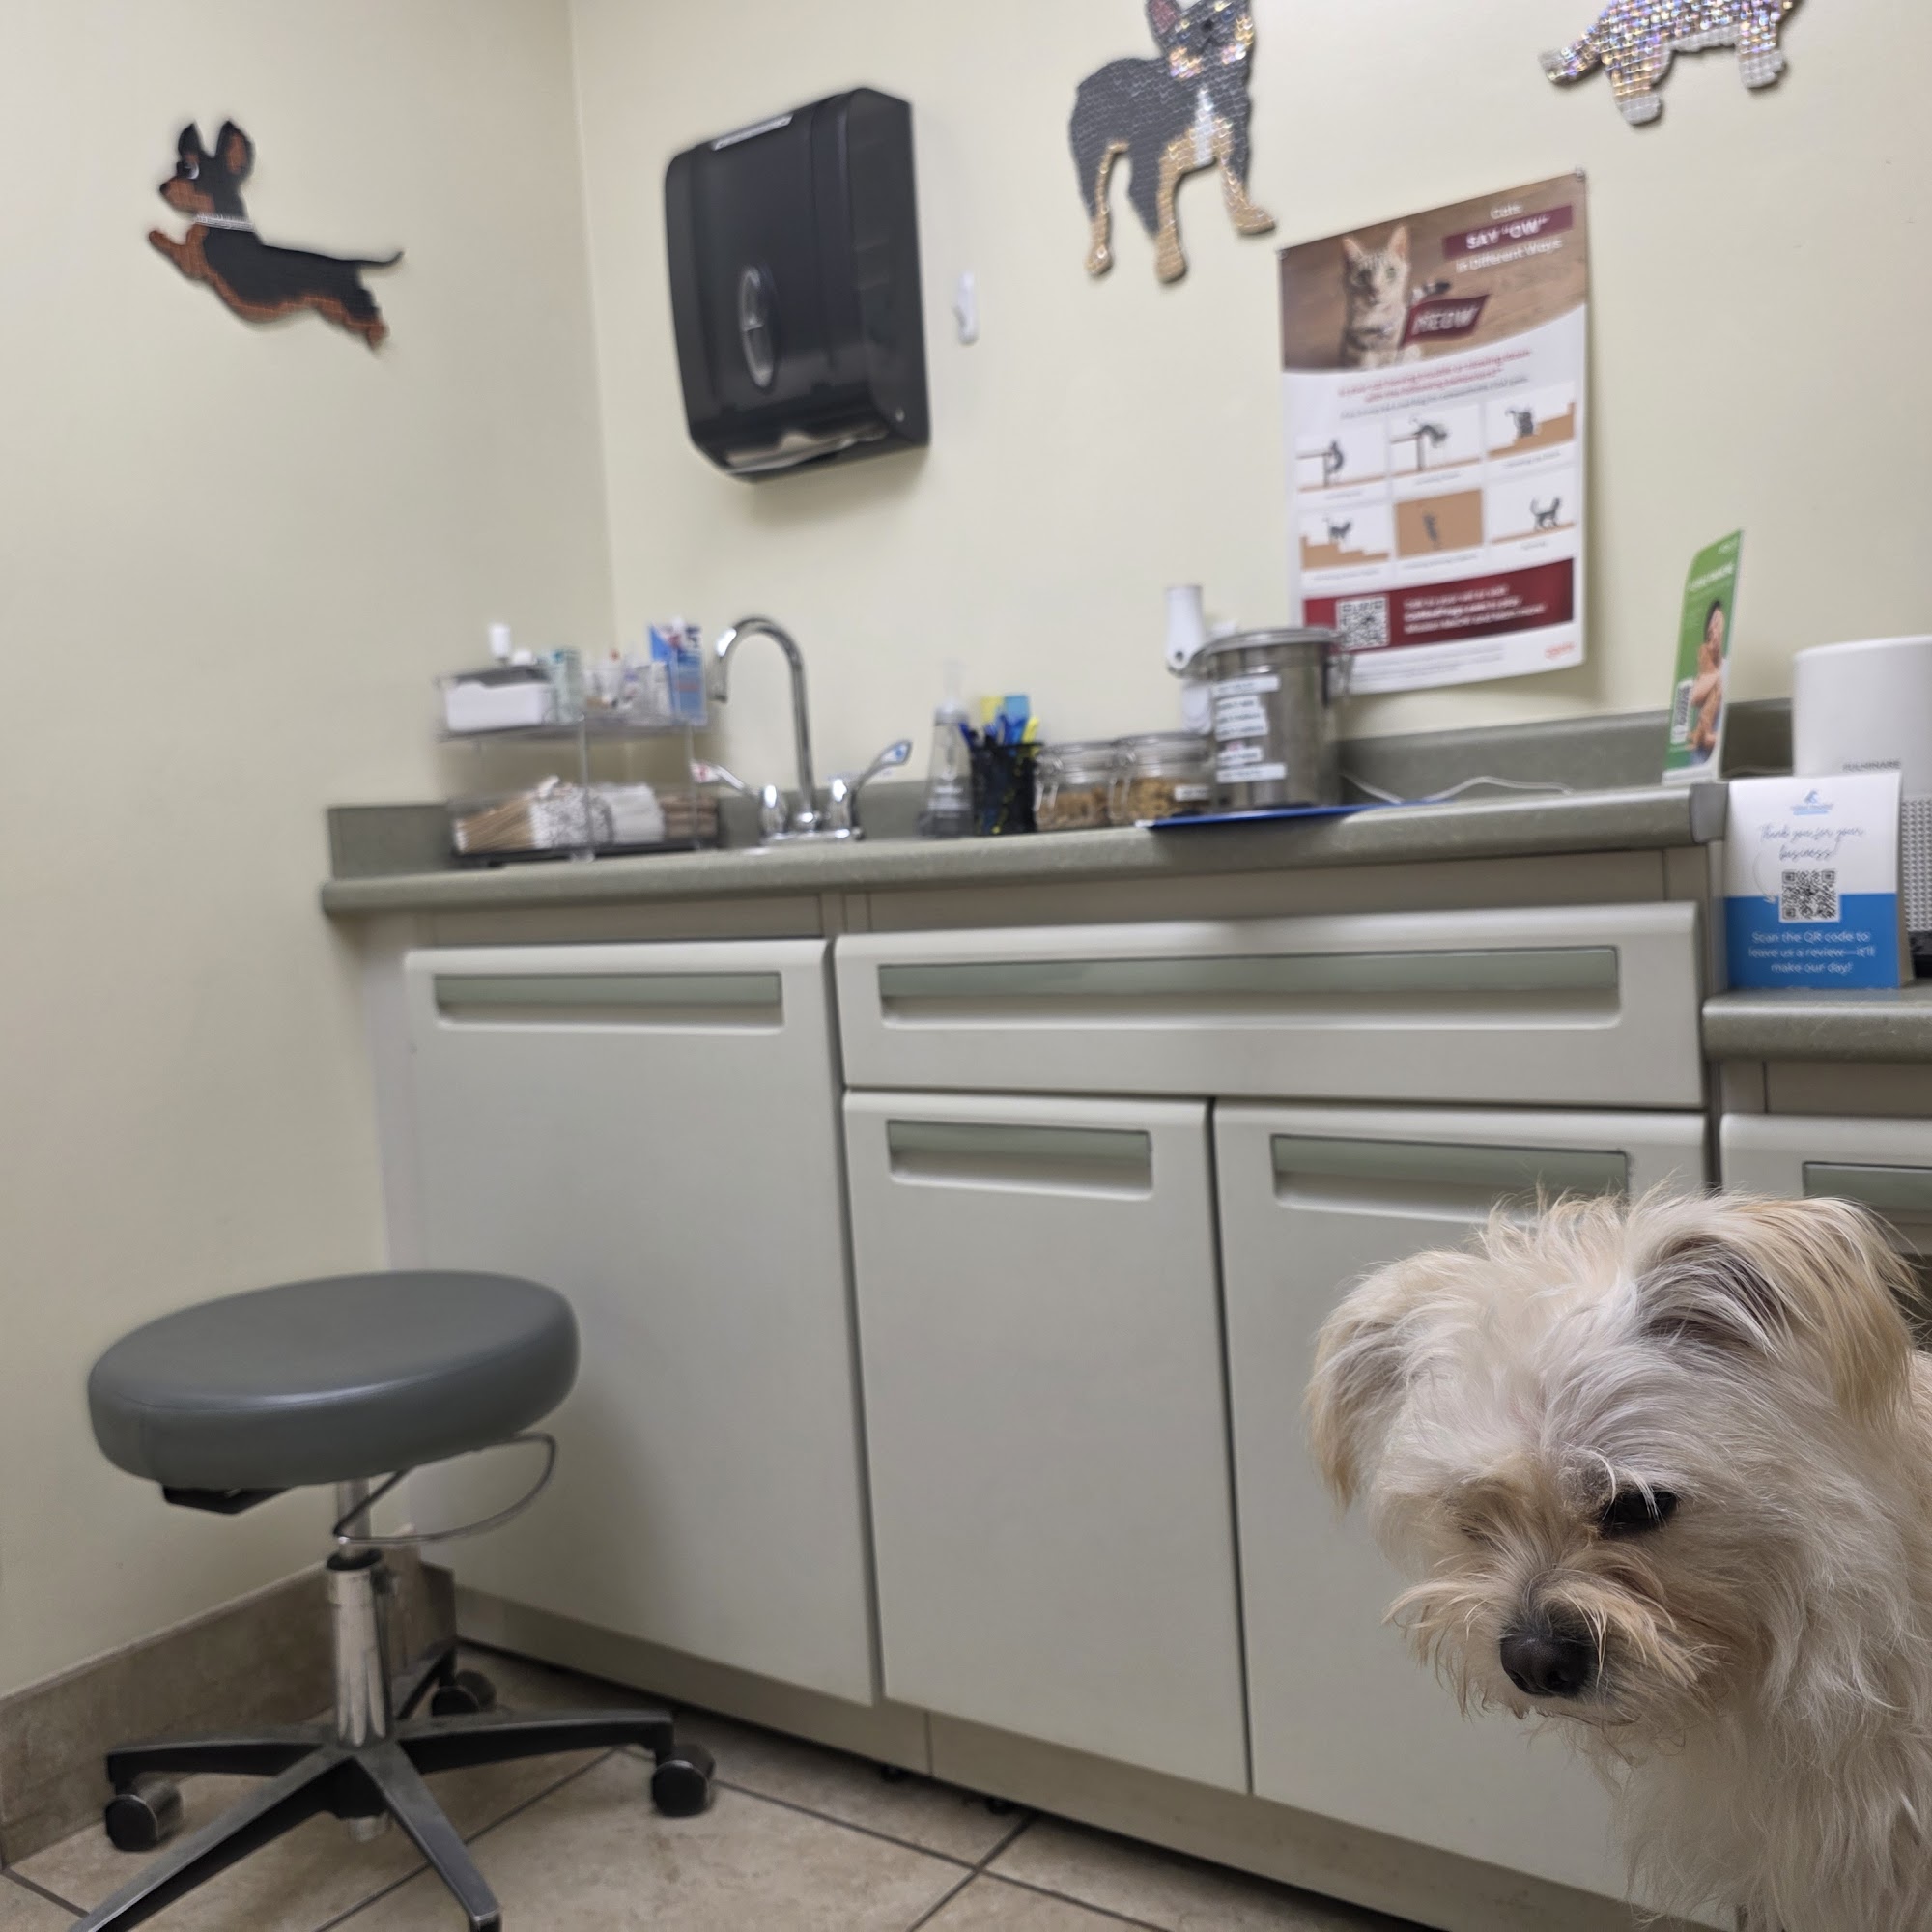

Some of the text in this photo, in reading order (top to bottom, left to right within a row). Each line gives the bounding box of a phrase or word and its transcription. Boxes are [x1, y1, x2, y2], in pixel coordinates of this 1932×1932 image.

[1466, 226, 1500, 249] SAY
[1470, 245, 1522, 271] Different
[1524, 237, 1563, 258] Ways
[1790, 828, 1813, 843] you
[1812, 826, 1834, 841] for
[1836, 827, 1864, 841] your
[1752, 930, 1871, 944] Scan the QR code to
[1748, 947, 1778, 958] leave
[1780, 950, 1793, 958] us
[1796, 950, 1804, 958] a
[1771, 961, 1854, 977] make our day!
